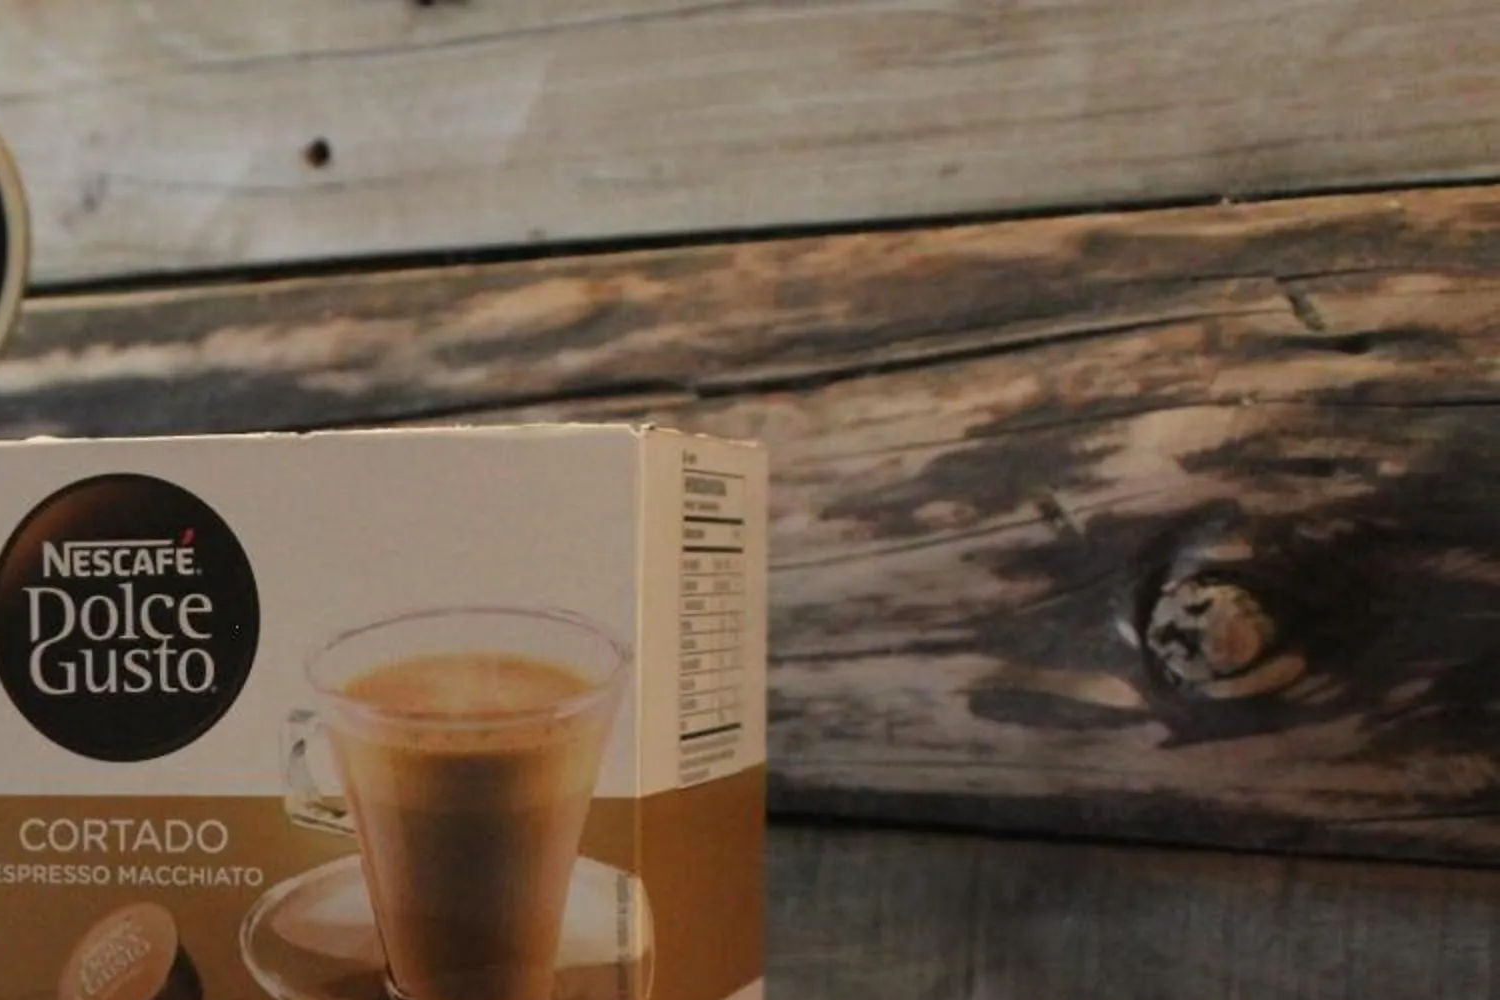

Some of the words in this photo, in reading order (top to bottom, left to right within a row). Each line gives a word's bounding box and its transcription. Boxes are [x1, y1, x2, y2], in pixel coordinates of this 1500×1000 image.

[22, 582, 214, 644] Dolce
[28, 638, 217, 695] Gusto
[18, 817, 229, 854] CORTADO
[117, 866, 265, 888] MACCHIATO
